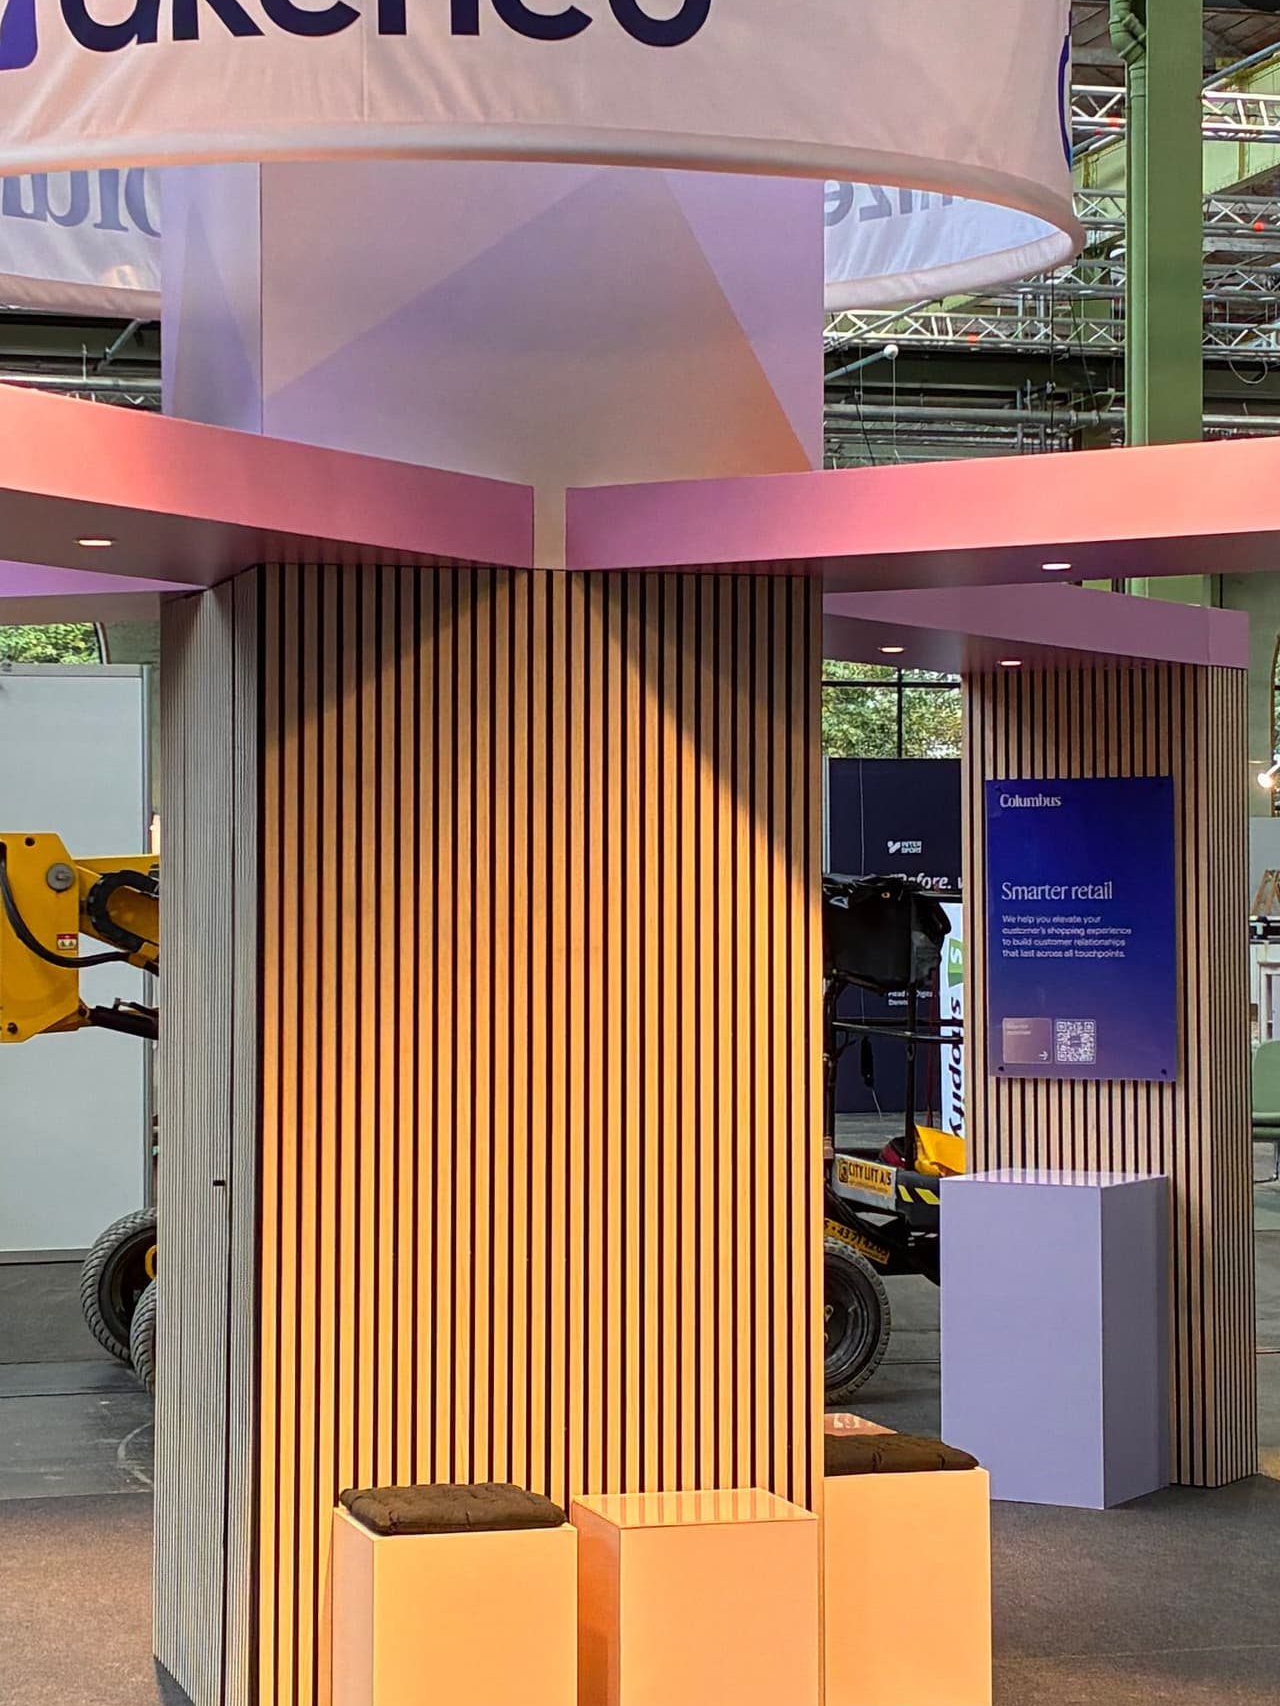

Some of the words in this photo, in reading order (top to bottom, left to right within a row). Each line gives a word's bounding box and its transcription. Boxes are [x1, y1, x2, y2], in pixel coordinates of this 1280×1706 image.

[999, 793, 1062, 808] Columbus
[1001, 881, 1069, 900] Smarter
[1071, 881, 1113, 900] retail
